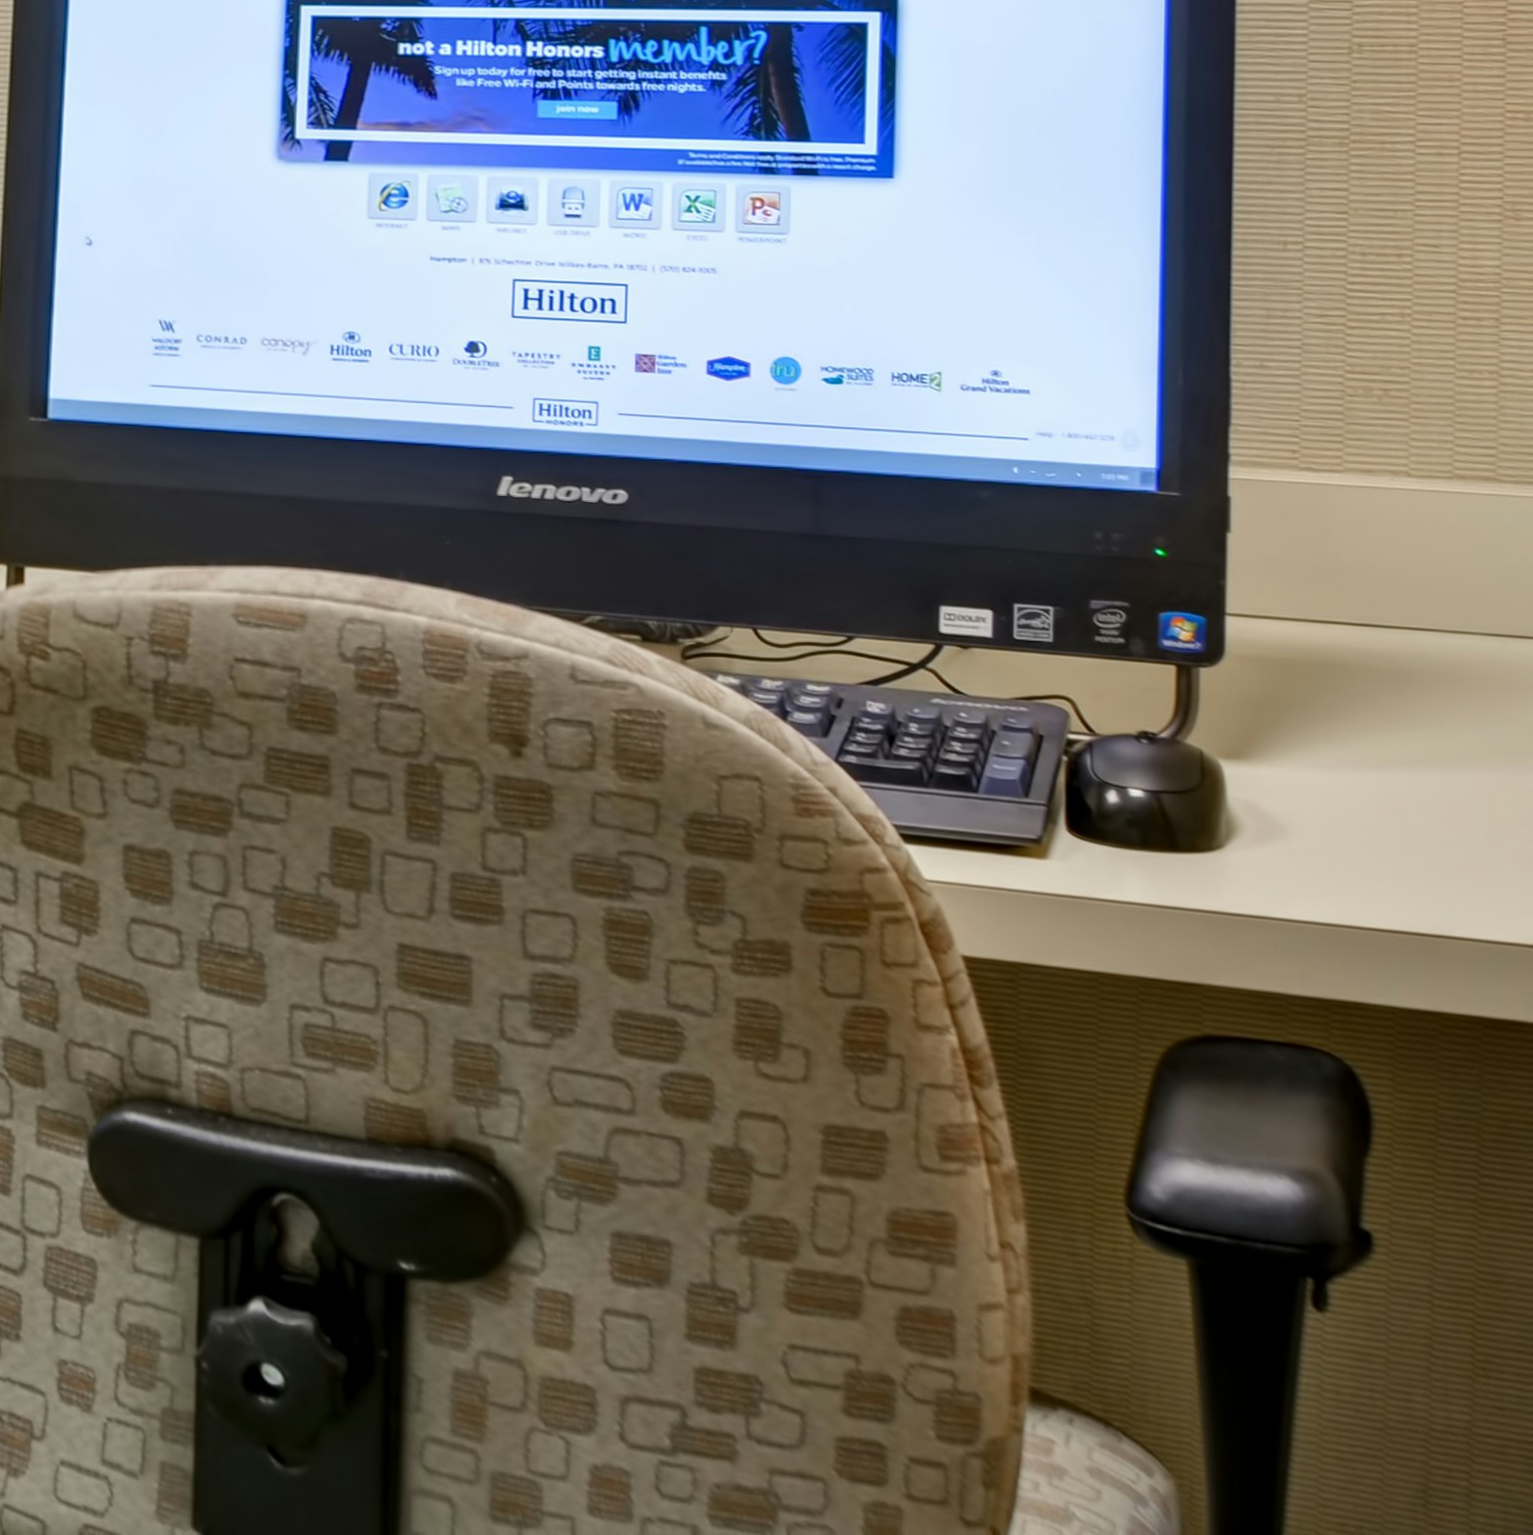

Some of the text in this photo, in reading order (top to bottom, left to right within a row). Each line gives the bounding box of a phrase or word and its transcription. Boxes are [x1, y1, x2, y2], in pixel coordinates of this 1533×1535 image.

[398, 25, 769, 66] not a Hilton Honors member?
[434, 66, 728, 81] Sign up today for free to start getting instant benefits
[456, 78, 707, 93] like Free Wi-Fi and Points towards free nights.
[556, 104, 599, 114] join now
[522, 288, 617, 314] Hilton
[197, 335, 247, 344] CONRAD
[330, 344, 372, 357] Hilton
[389, 343, 439, 357] CURIO
[538, 403, 593, 420] Hilton
[496, 475, 629, 505] lenovo
